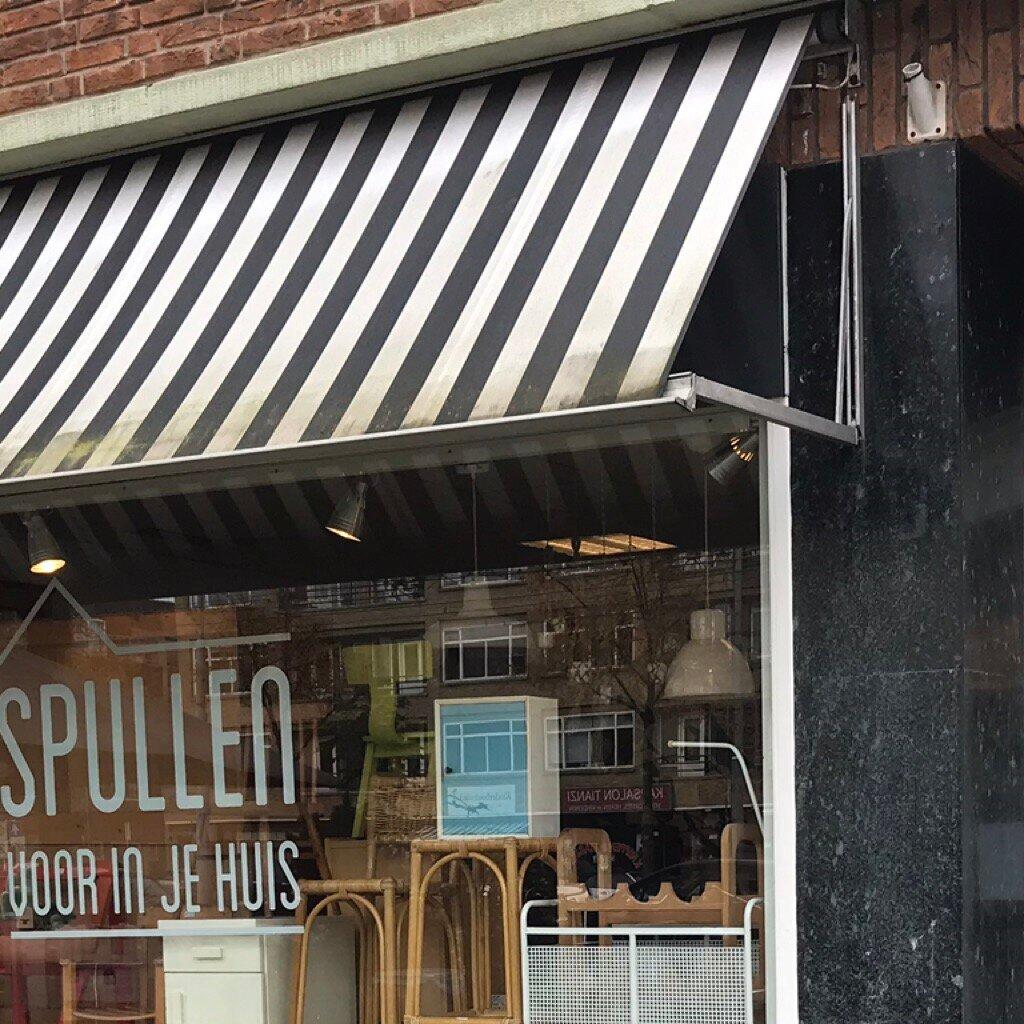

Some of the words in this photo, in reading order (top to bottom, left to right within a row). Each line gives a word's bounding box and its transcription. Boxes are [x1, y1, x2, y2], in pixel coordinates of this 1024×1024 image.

[0, 666, 296, 818] SPULLEN
[7, 849, 98, 917] VOOR
[111, 847, 145, 914] IN
[160, 843, 200, 914] JE
[215, 840, 300, 912] HUIS
